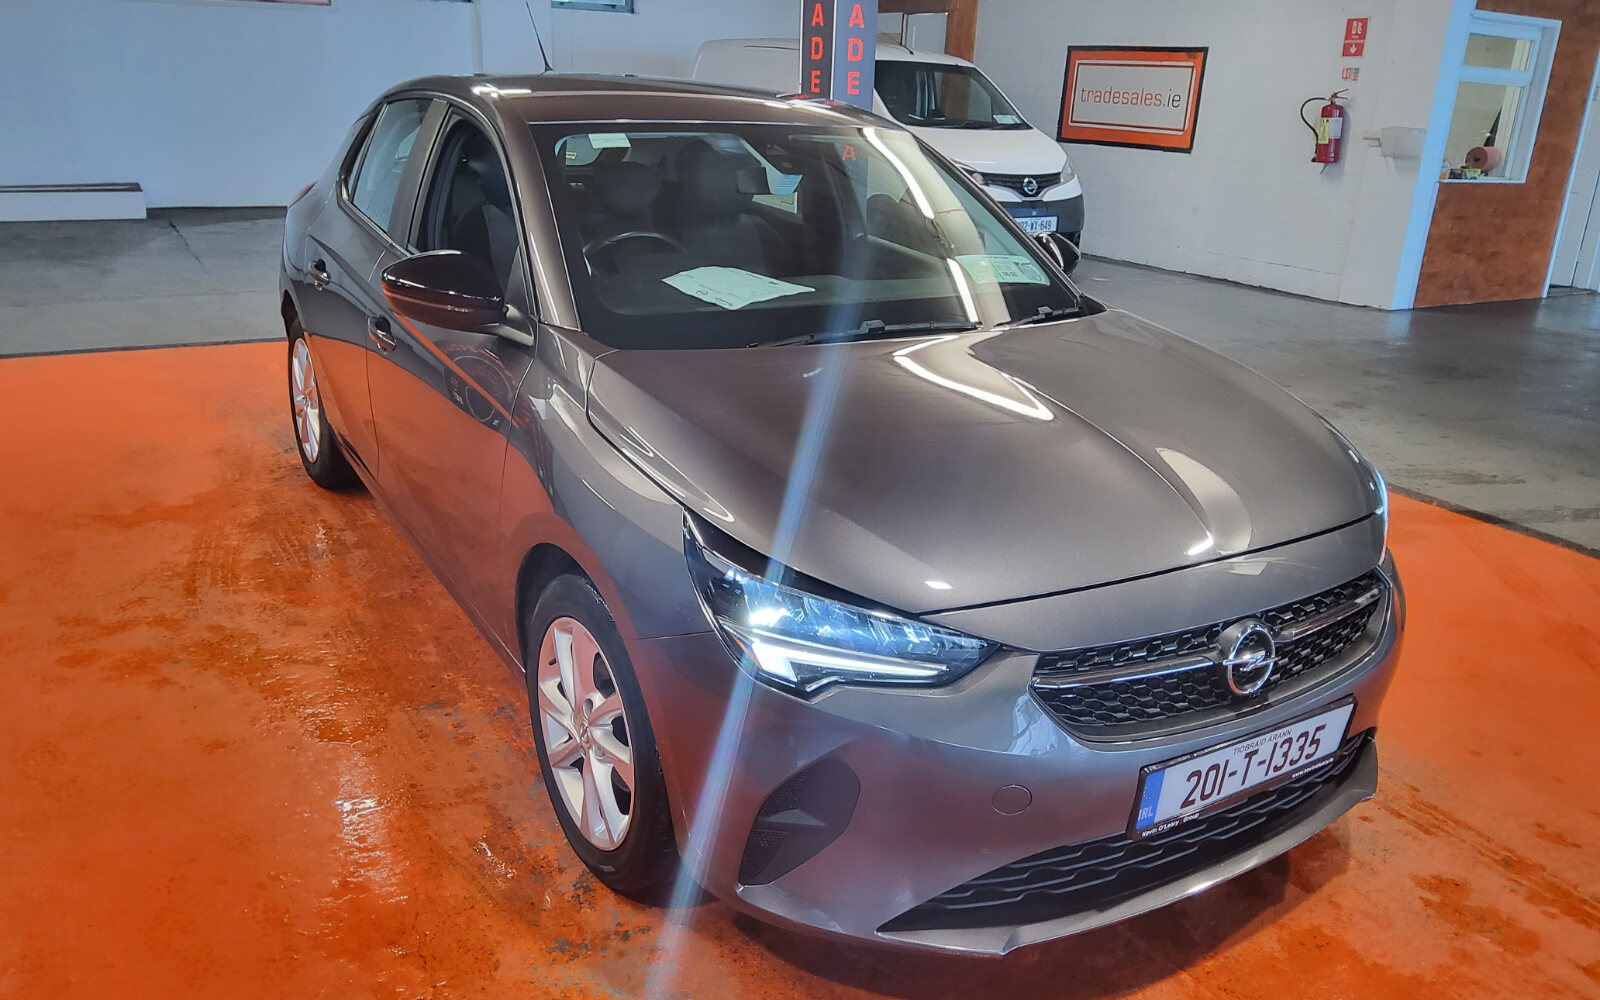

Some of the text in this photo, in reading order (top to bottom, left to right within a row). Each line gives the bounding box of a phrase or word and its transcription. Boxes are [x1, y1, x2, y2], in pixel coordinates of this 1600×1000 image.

[1080, 86, 1182, 109] tradesales.ie
[1233, 739, 1267, 755] TIOBRAID
[1179, 723, 1328, 810] 201-T-1335
[1137, 805, 1154, 821] IRL
[1141, 828, 1158, 838] Kevin
[1183, 813, 1200, 823] Group
